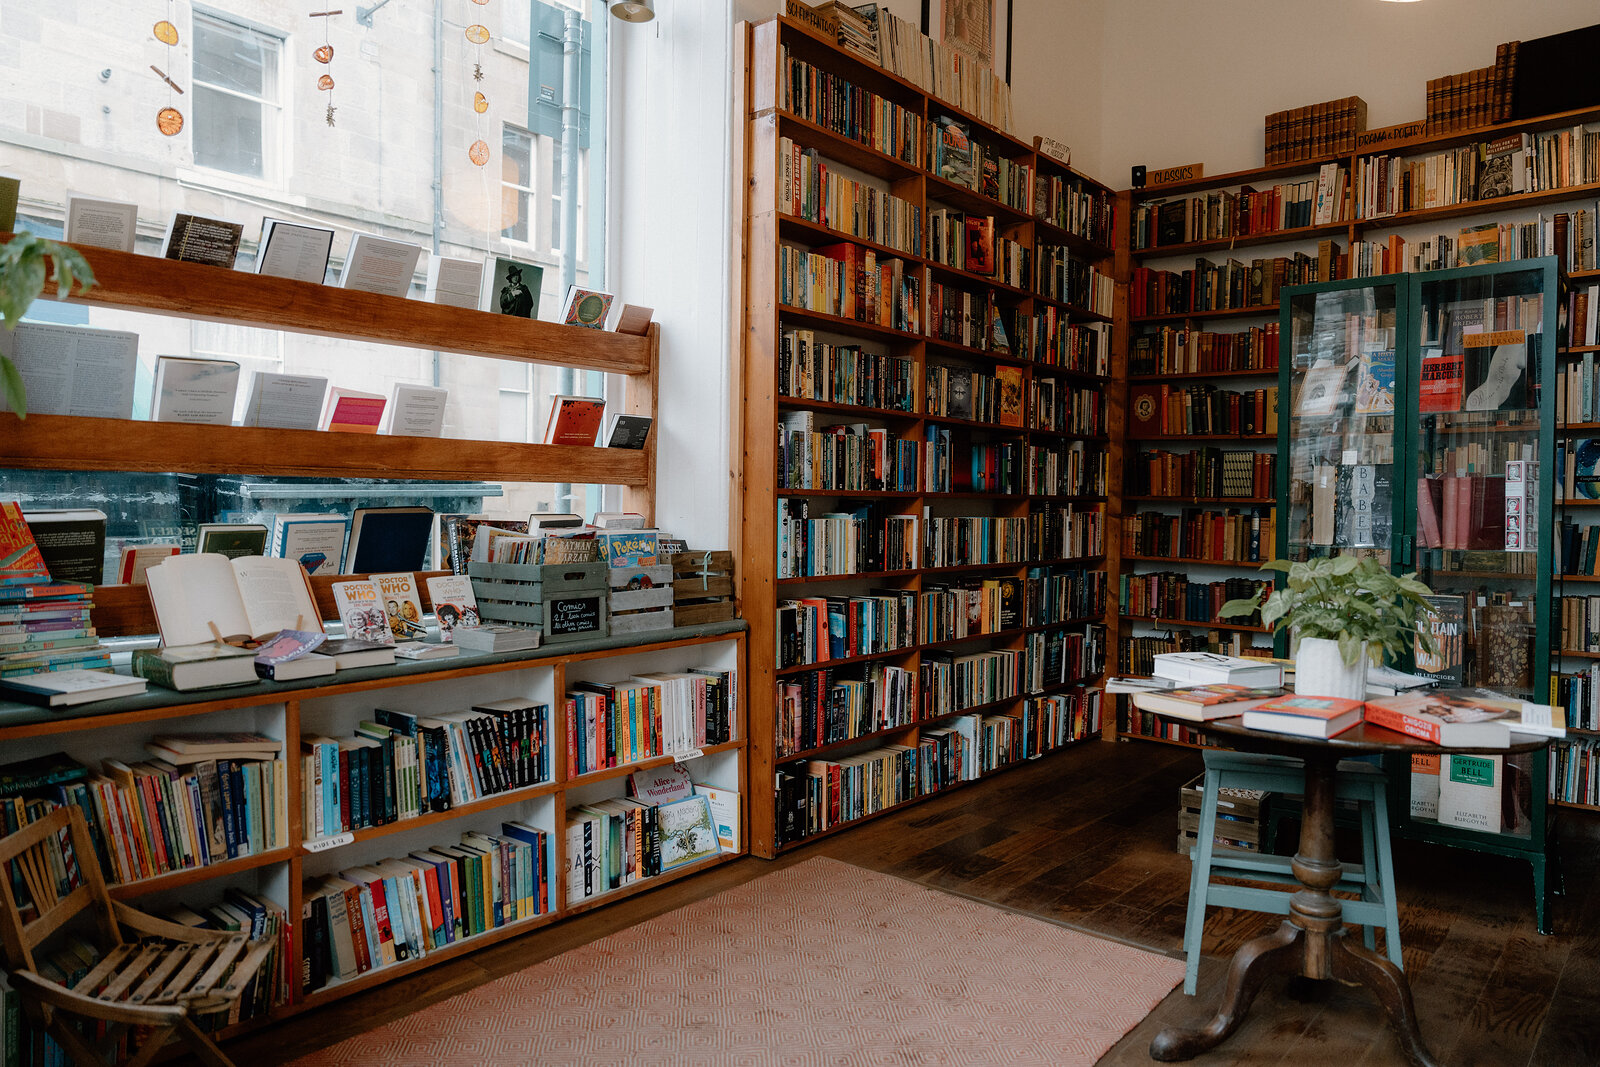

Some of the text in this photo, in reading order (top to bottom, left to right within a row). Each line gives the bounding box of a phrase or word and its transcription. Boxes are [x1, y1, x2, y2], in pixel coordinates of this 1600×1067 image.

[787, 1, 798, 17] SCI
[810, 11, 837, 36] FANTASY
[1358, 131, 1387, 147] DRAMA
[1393, 123, 1425, 140] POETRY
[943, 131, 968, 151] DUNE
[1154, 167, 1193, 184] CLASSICS
[1455, 313, 1483, 321] ROBERT
[1465, 336, 1522, 347] WINTERSON
[1423, 361, 1463, 373] HERBERT
[1421, 370, 1463, 381] MARCUSE
[1357, 467, 1369, 543] BABEL
[558, 540, 592, 552] BATMAN
[343, 584, 374, 592] DOCTOR
[380, 583, 411, 594] WHO
[344, 591, 377, 601] WHO
[557, 601, 586, 612] Comics
[1423, 672, 1456, 681] LEIPCIGER
[1402, 715, 1433, 731] CHIGOZIE
[1404, 724, 1431, 739] OBIOMA
[1453, 758, 1491, 769] GERTRUDE
[1461, 767, 1483, 777] BELL
[653, 777, 670, 787] Alice
[647, 781, 686, 798] Wonderland
[1411, 806, 1437, 814] GOYNE
[1456, 810, 1487, 820] ELIZABETH
[1454, 816, 1489, 827] BURGOYNE
[348, 897, 357, 930] PYRAMID
